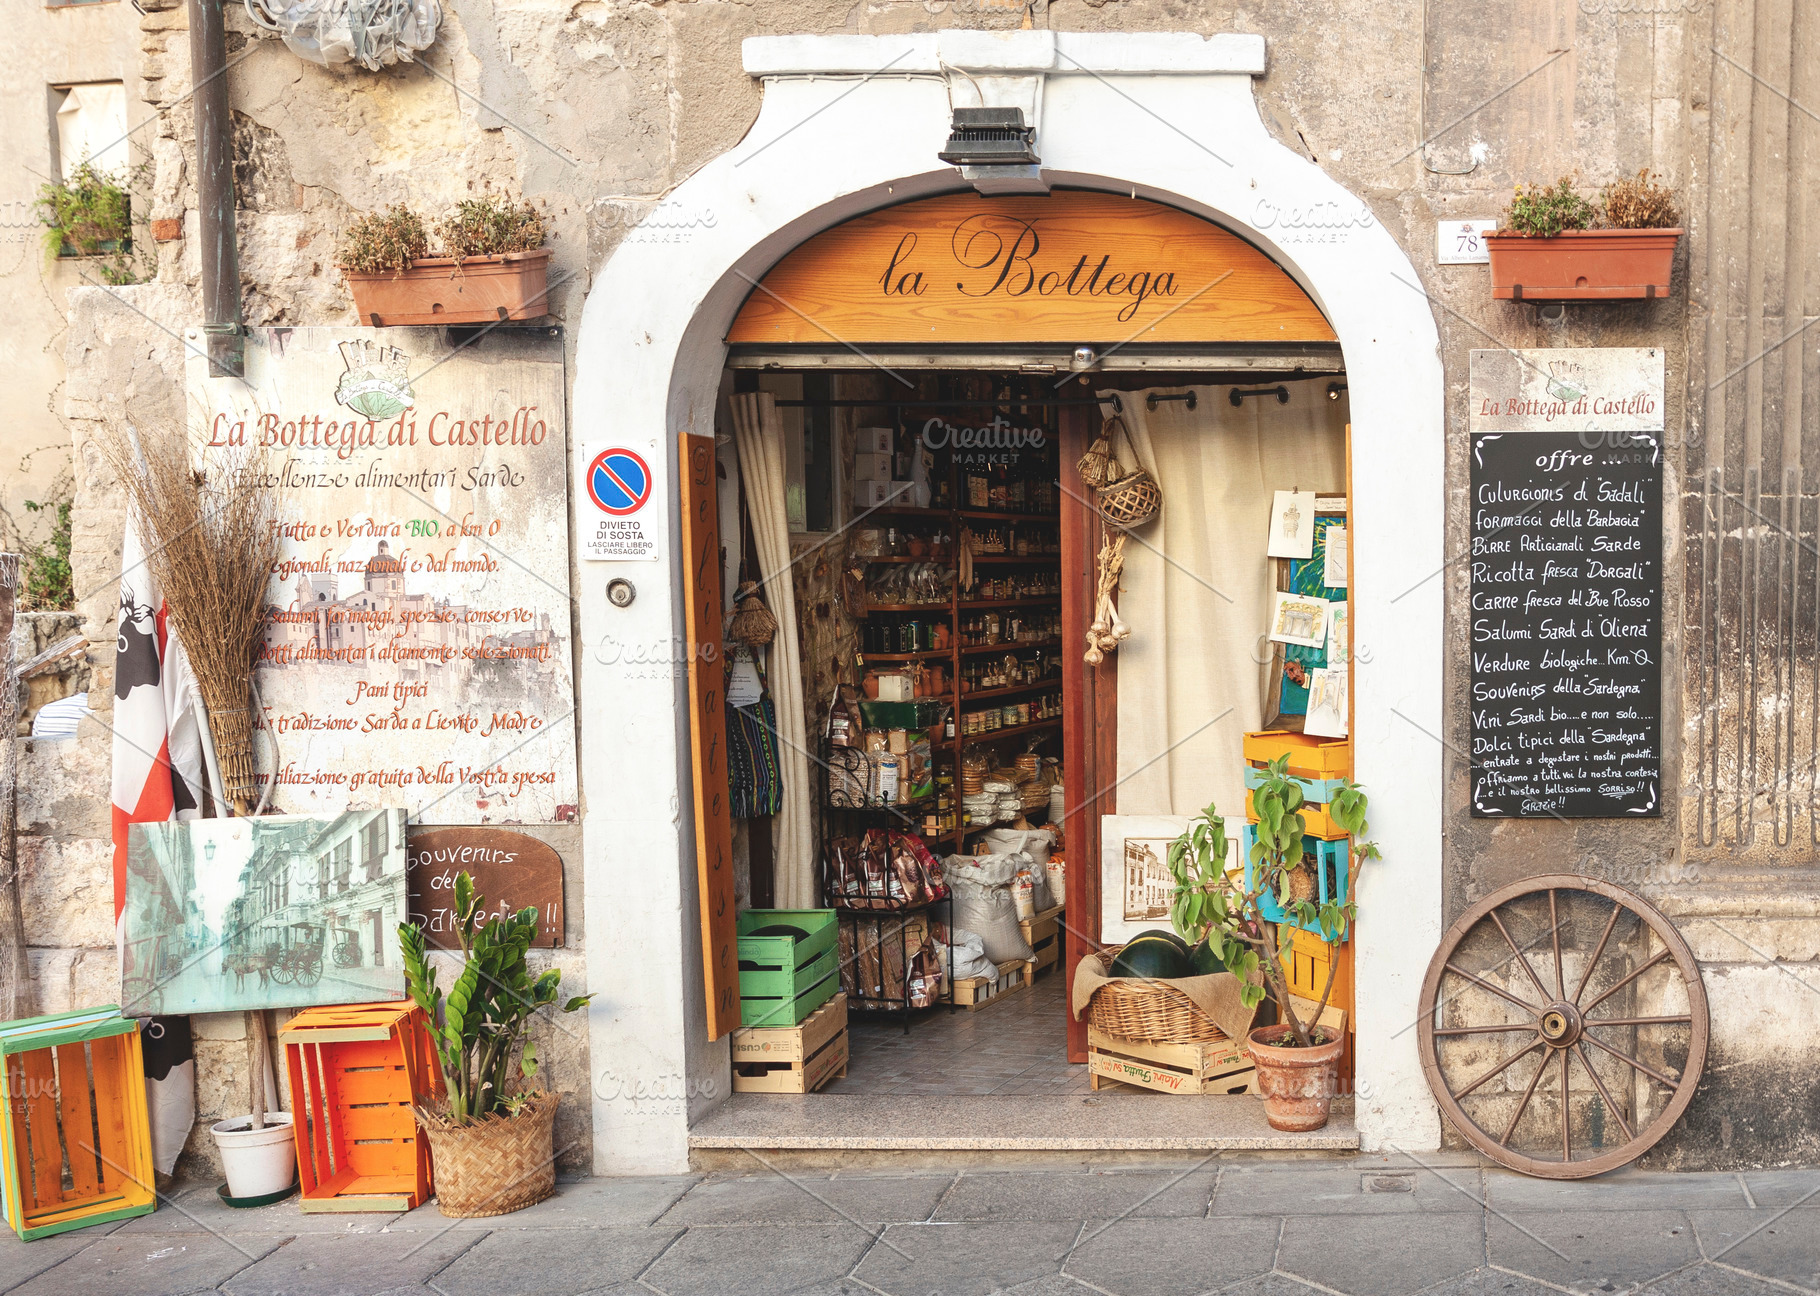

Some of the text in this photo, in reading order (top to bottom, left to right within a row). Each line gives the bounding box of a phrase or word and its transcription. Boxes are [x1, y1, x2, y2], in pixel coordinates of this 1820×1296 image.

[1456, 235, 1478, 252] 78
[878, 213, 1179, 322] la Bottega
[1479, 393, 1655, 422] La Bottega di Castello
[207, 405, 547, 460] La Bottega di Castello
[1535, 450, 1594, 472] offre
[354, 458, 457, 488] alimentari
[461, 463, 525, 492] Sarde
[1573, 477, 1589, 502] di
[320, 524, 332, 538] e
[337, 518, 401, 538] Verdura
[404, 518, 442, 538] BIO,
[446, 524, 457, 538] a
[460, 512, 483, 538] km
[600, 521, 641, 530] DIVIETO
[1550, 509, 1583, 528] della
[596, 531, 644, 540] DI SOSTA
[626, 541, 654, 549] LIBERO
[1590, 536, 1641, 553] Sarde
[271, 548, 500, 581] egionali, nazionali e dal mondo.
[1471, 560, 1535, 584] Ricotta
[1472, 591, 1519, 612] Carne
[1523, 589, 1563, 615] fresca
[1568, 589, 1583, 607] del
[325, 604, 395, 631] formaggi,
[397, 607, 460, 638] spezie,
[464, 608, 533, 624] conserve
[1474, 619, 1532, 642] Salumi
[1538, 618, 1577, 640] Sardi
[1581, 618, 1594, 638] di
[296, 636, 376, 664] alimentari
[378, 633, 458, 665] altamente
[461, 635, 552, 663] selezionati.
[1474, 651, 1531, 673] Verdure
[346, 680, 428, 710] Pani tipici
[1473, 681, 1547, 702] Souvenirs
[1553, 678, 1582, 694] della
[278, 711, 358, 734] tradizione
[361, 709, 409, 733] Sarda
[412, 717, 422, 730] a
[426, 712, 479, 733] Lievito
[481, 712, 543, 737] Madre
[1472, 709, 1502, 730] Vini
[1506, 707, 1546, 726] Sardi
[1591, 711, 1609, 720] non
[1473, 736, 1513, 755] Dolci
[1518, 732, 1554, 750] tipici
[1559, 728, 1586, 745] della
[1526, 757, 1533, 765] a
[1538, 750, 1580, 769] degustare
[1585, 751, 1589, 761] i
[1593, 749, 1616, 761] nostri
[349, 767, 413, 791] gratuita
[417, 761, 454, 784] della
[458, 769, 508, 788] Vostra
[509, 770, 556, 797] spesa
[1478, 771, 1529, 787] offriamo
[1532, 774, 1539, 782] a
[1541, 768, 1561, 782] tutti
[1562, 771, 1575, 779] voi
[1577, 767, 1587, 779] la
[1590, 766, 1623, 778] nostra
[1498, 786, 1506, 796] il
[1510, 784, 1541, 796] nostro
[1545, 782, 1591, 795] bellissimo
